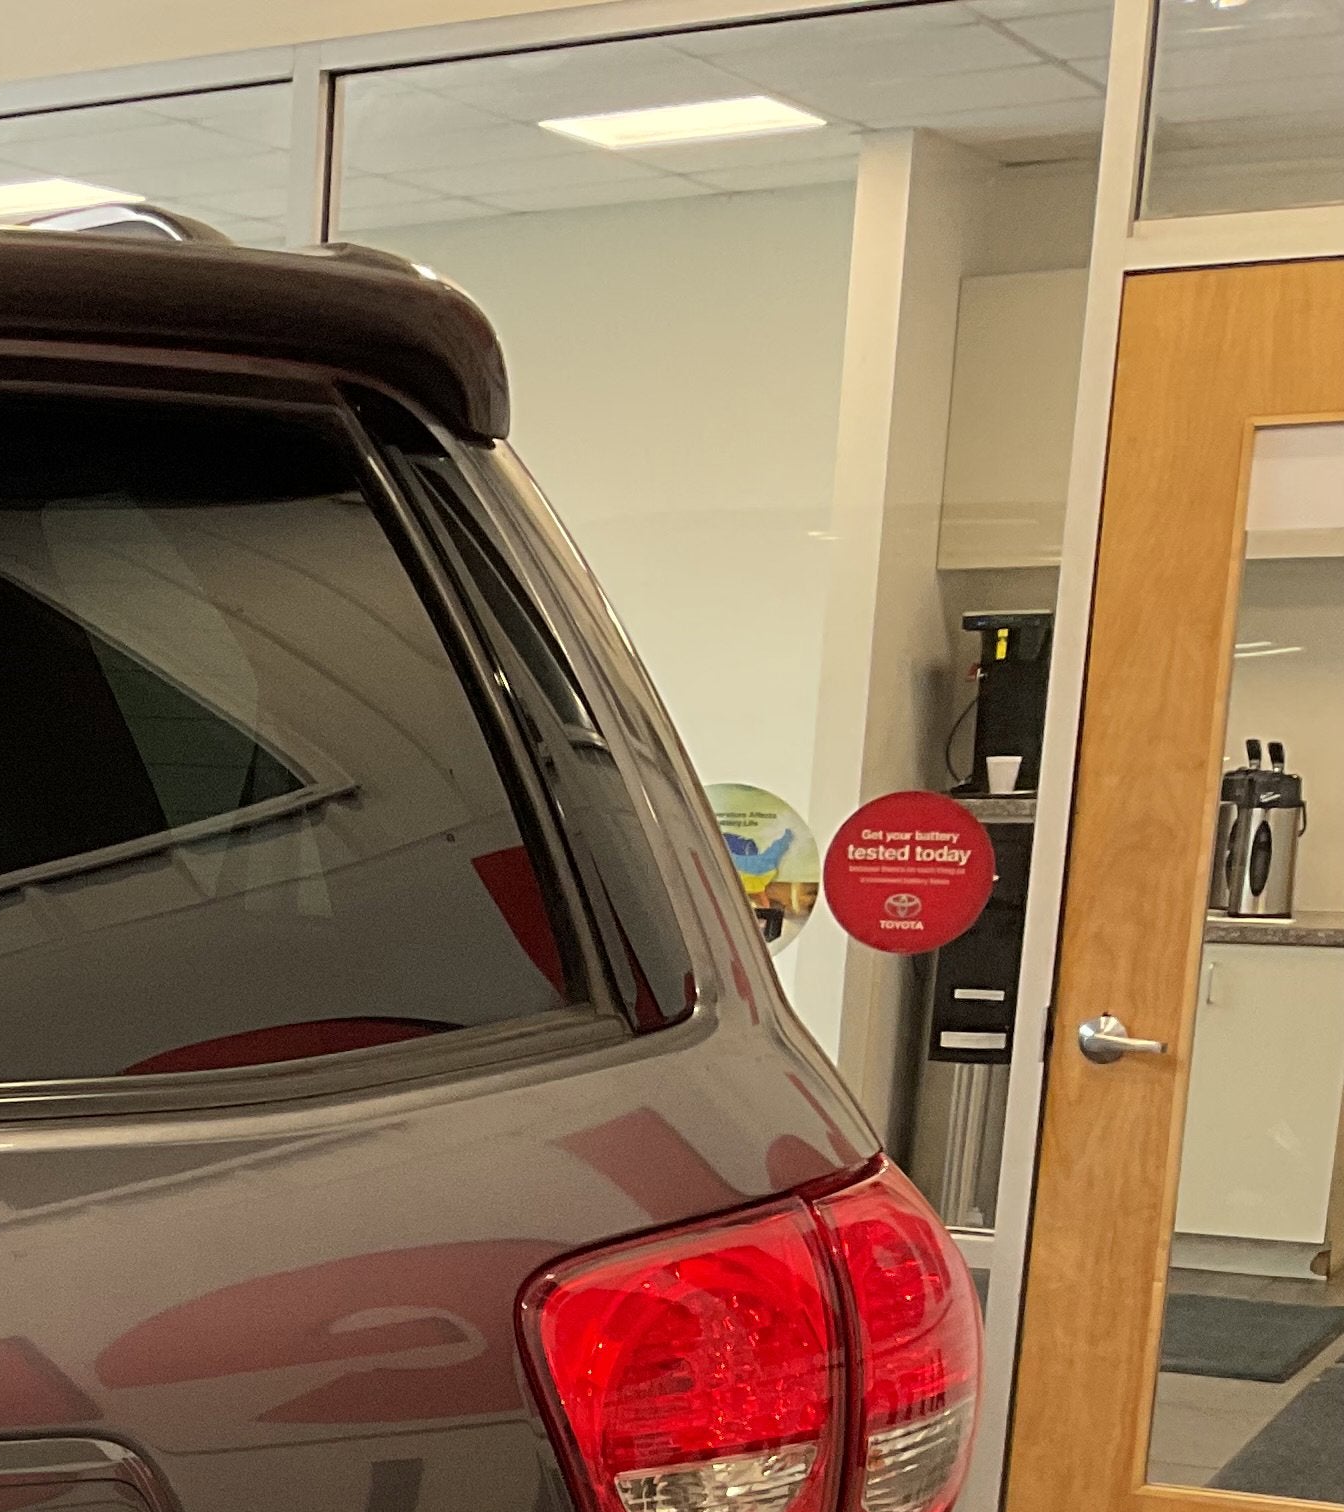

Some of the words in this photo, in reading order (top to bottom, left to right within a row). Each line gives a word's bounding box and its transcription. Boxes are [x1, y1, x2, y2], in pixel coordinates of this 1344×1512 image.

[862, 829, 883, 840] Get
[886, 831, 912, 842] your
[915, 830, 960, 844] battery
[848, 844, 910, 860] tested
[915, 845, 972, 866] today
[880, 920, 924, 930] TOYOTA
